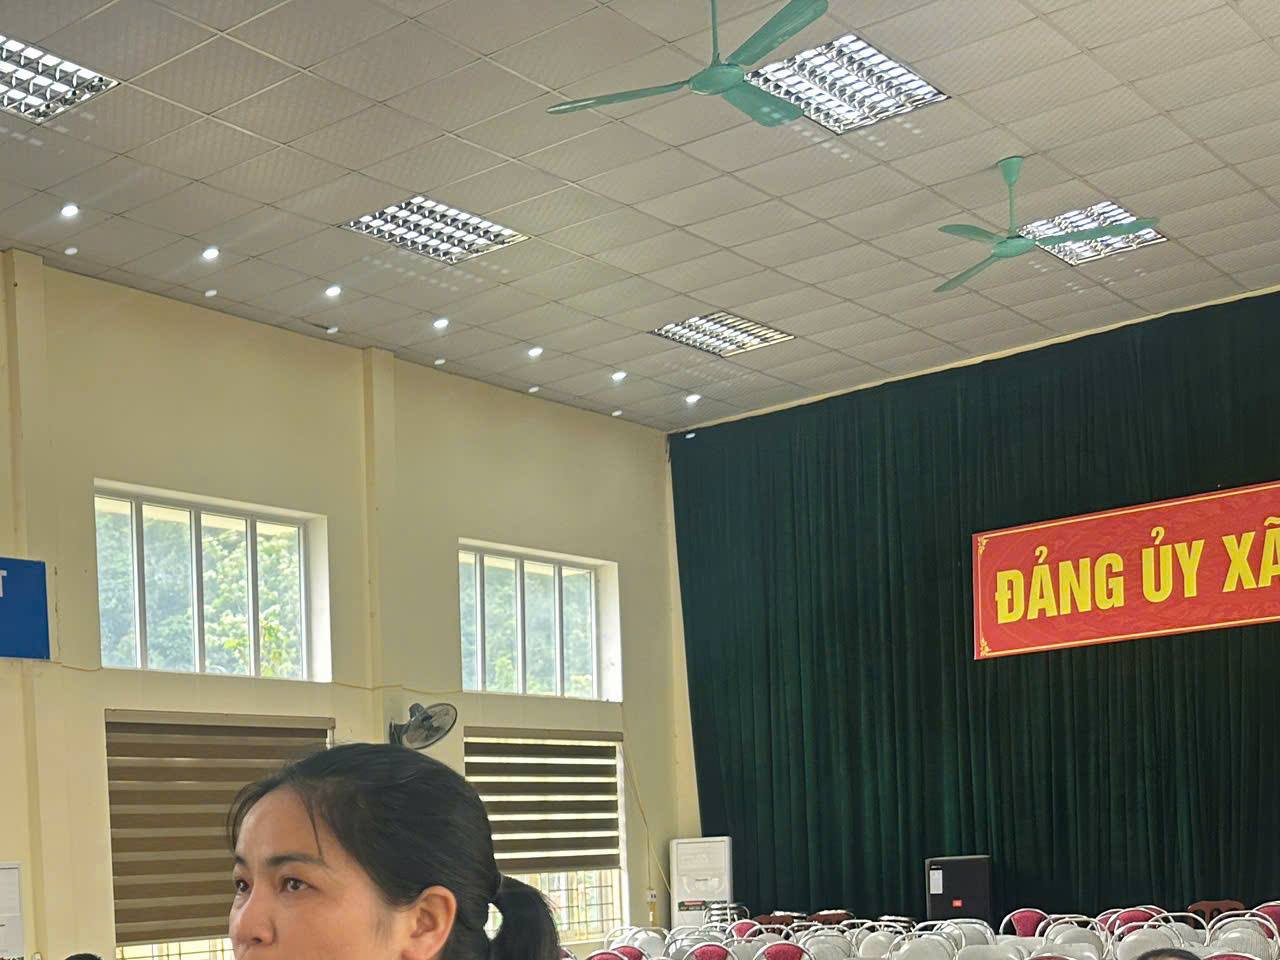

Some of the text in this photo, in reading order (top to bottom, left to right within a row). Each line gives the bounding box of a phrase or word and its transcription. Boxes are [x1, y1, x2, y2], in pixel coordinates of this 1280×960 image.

[995, 516, 1280, 624] ĐẢNG ỦY XÃ
